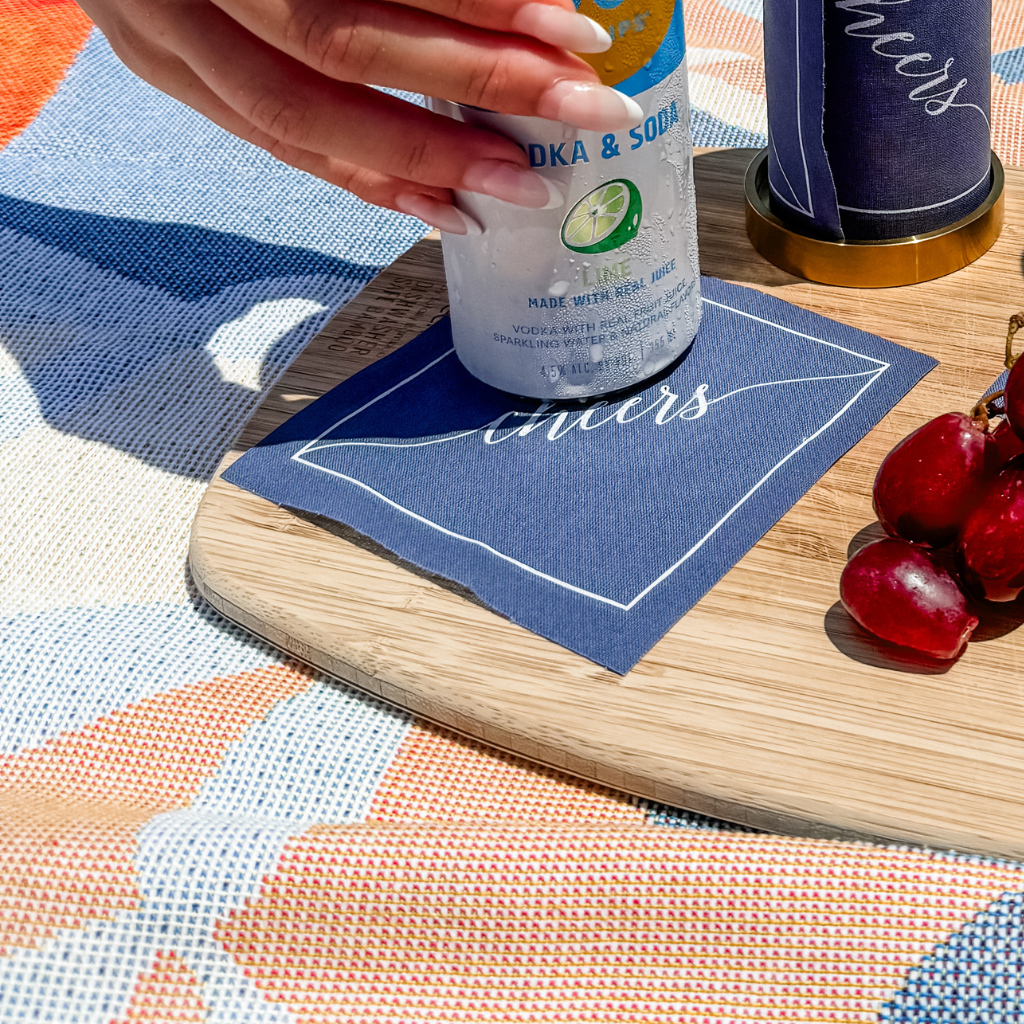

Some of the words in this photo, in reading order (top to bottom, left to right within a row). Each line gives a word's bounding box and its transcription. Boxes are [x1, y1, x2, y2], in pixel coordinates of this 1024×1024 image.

[608, 11, 651, 43] IPS
[528, 140, 590, 168] DKA
[601, 133, 621, 160] &
[629, 101, 679, 151] SODA
[349, 280, 434, 356] DISHWASHER
[528, 296, 566, 309] MADE
[573, 291, 609, 308] WITH
[327, 306, 385, 352] BAMBOO
[493, 332, 561, 349] SPARKLING
[512, 324, 557, 336] VODKA
[562, 323, 596, 336] WITH
[484, 383, 710, 445] cheers
